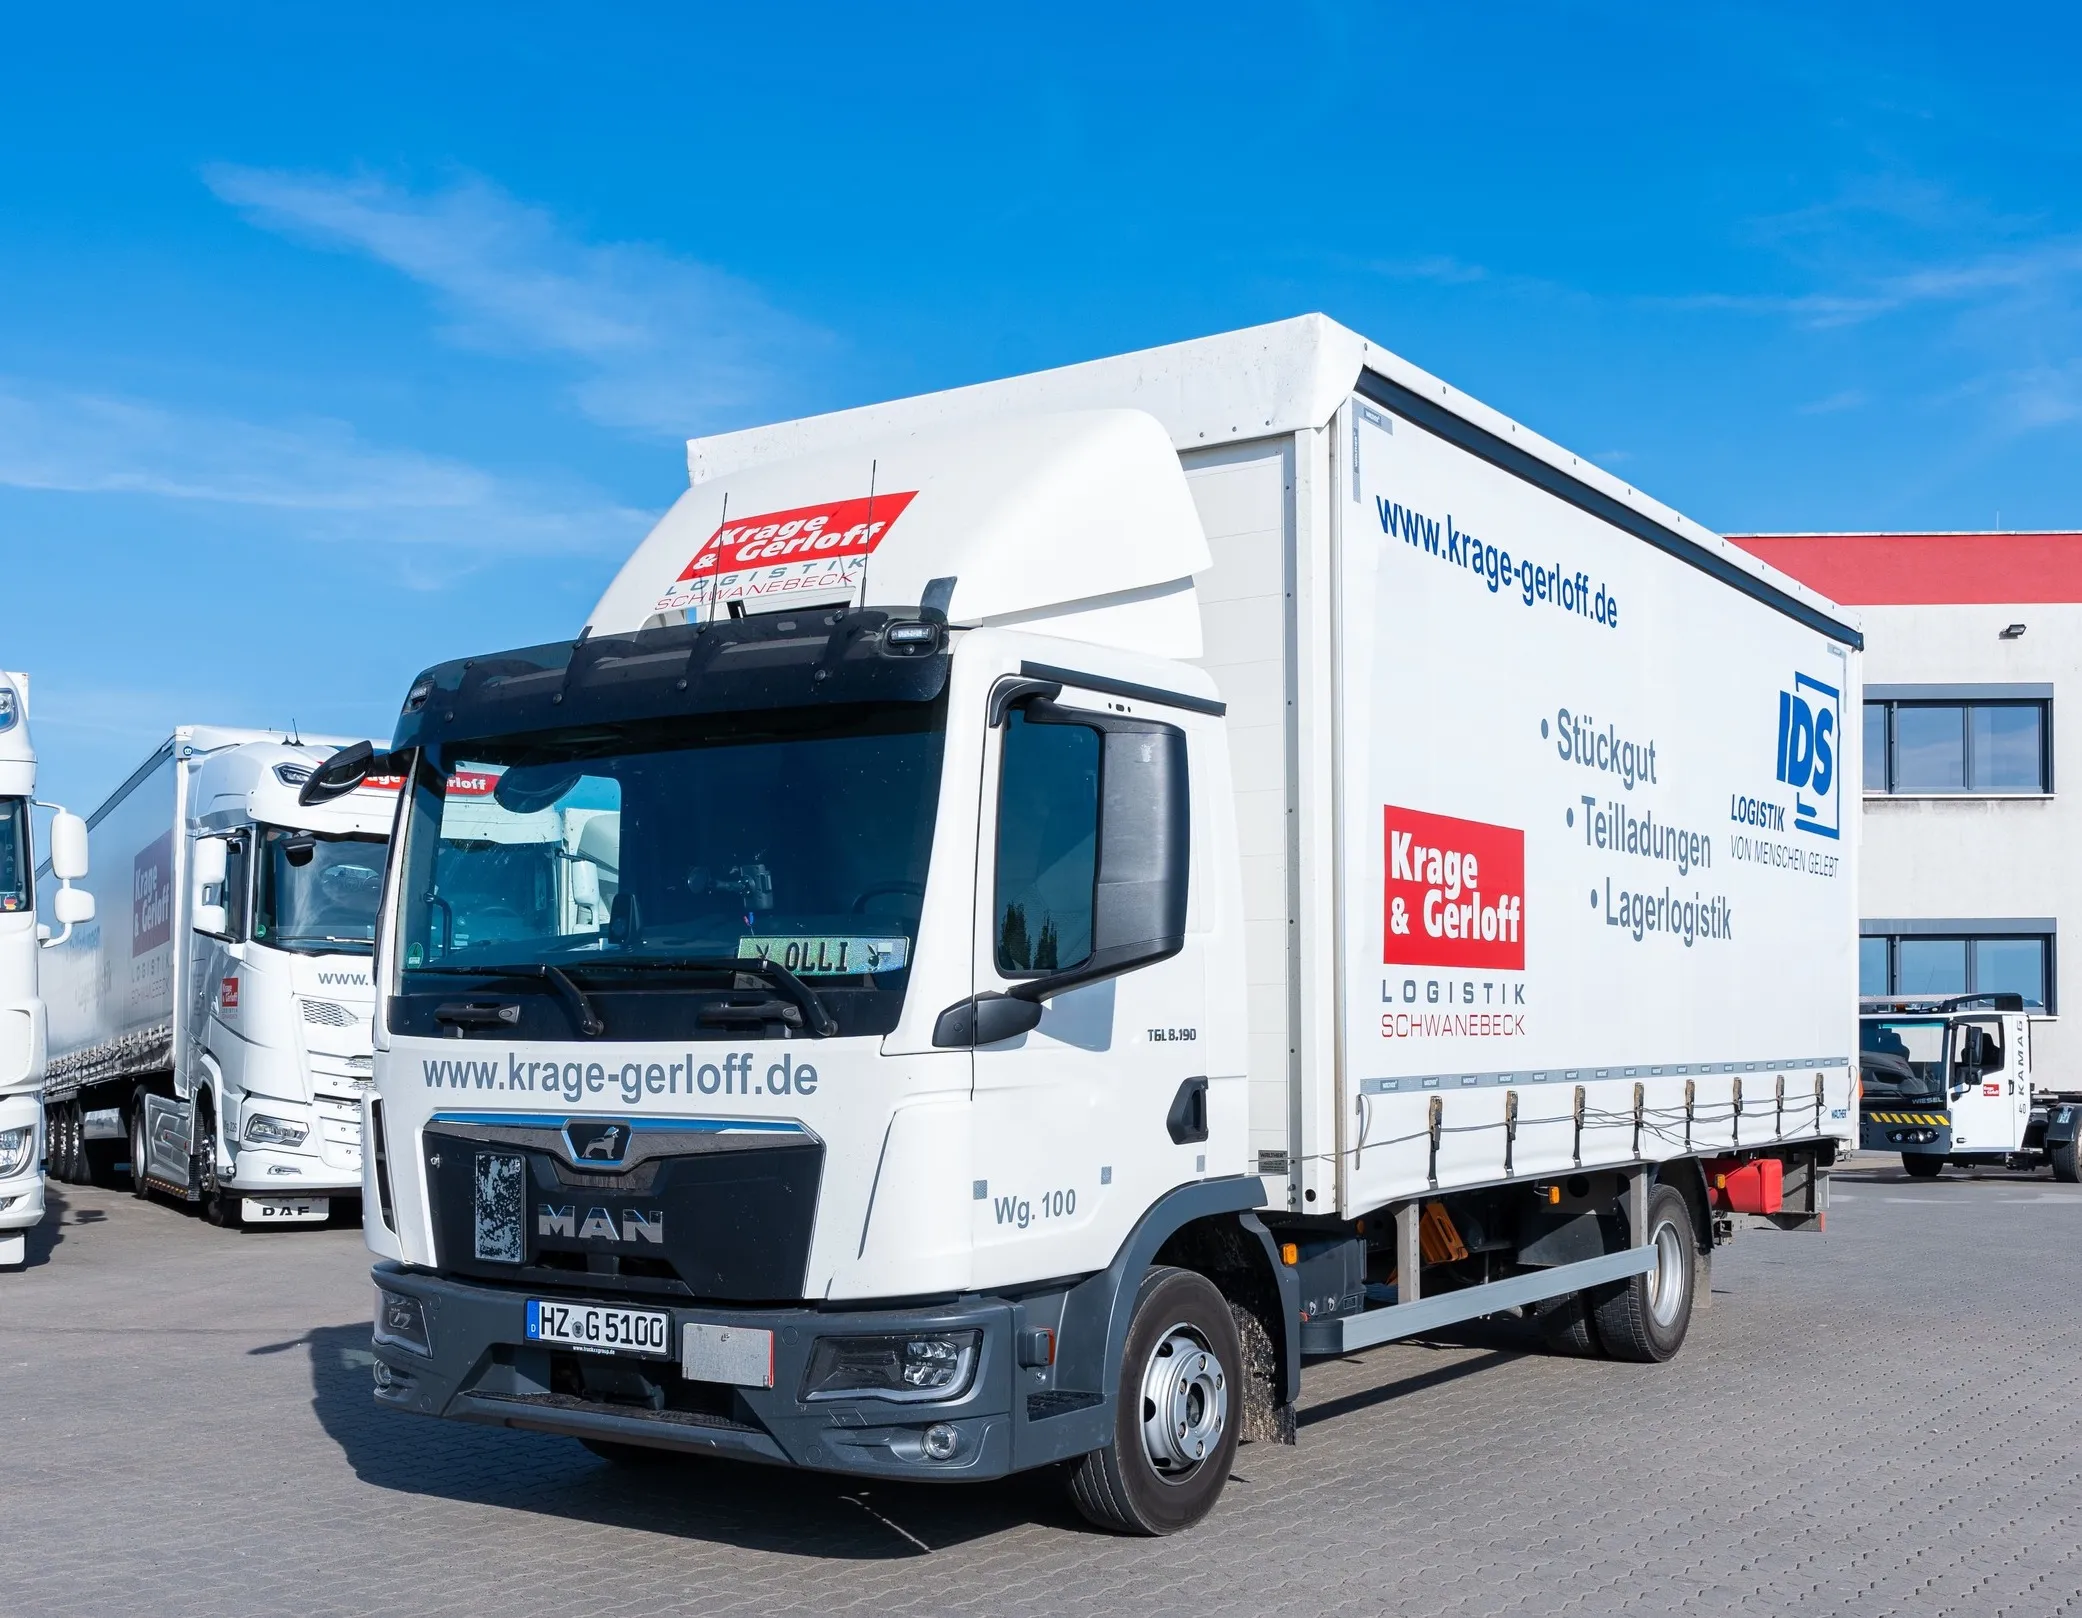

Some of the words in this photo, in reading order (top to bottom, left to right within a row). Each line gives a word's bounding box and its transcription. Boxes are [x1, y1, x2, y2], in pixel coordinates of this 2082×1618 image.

[692, 552, 717, 570] &
[735, 521, 887, 562] Gerloff
[709, 515, 829, 548] Krage
[665, 555, 870, 596] LOGISTIK
[1375, 494, 1618, 628] www.krage-gerloff.de
[654, 570, 857, 611] SCHWANEBECK
[1557, 707, 1657, 791] Stückgut
[1776, 689, 1834, 796] IDS
[1731, 794, 1786, 832] LOGISTIK
[1581, 795, 1711, 876] Teilladungen
[1391, 830, 1478, 900] Krage
[1731, 835, 1752, 862] VON
[1754, 840, 1806, 872] MENSCHEN
[1808, 852, 1840, 879] GELEBT
[1391, 897, 1410, 934] &
[1423, 889, 1521, 942] Gerloff
[1606, 876, 1732, 948] Lagerlogistik
[785, 941, 849, 972] OLLI
[318, 972, 369, 986] www.
[1382, 979, 1526, 1005] LOGISTIK
[1381, 1013, 1526, 1038] SCHWANEBECK
[422, 1052, 819, 1103] www.krage-gerloff.de
[2017, 1020, 2025, 1096] KAMAG
[262, 1206, 310, 1217] DAF
[538, 1204, 664, 1244] MAN
[994, 1195, 1036, 1229] Wg.
[1042, 1188, 1076, 1218] 100
[541, 1306, 570, 1338] HZ
[586, 1311, 600, 1341] G
[605, 1313, 664, 1348] 5100
